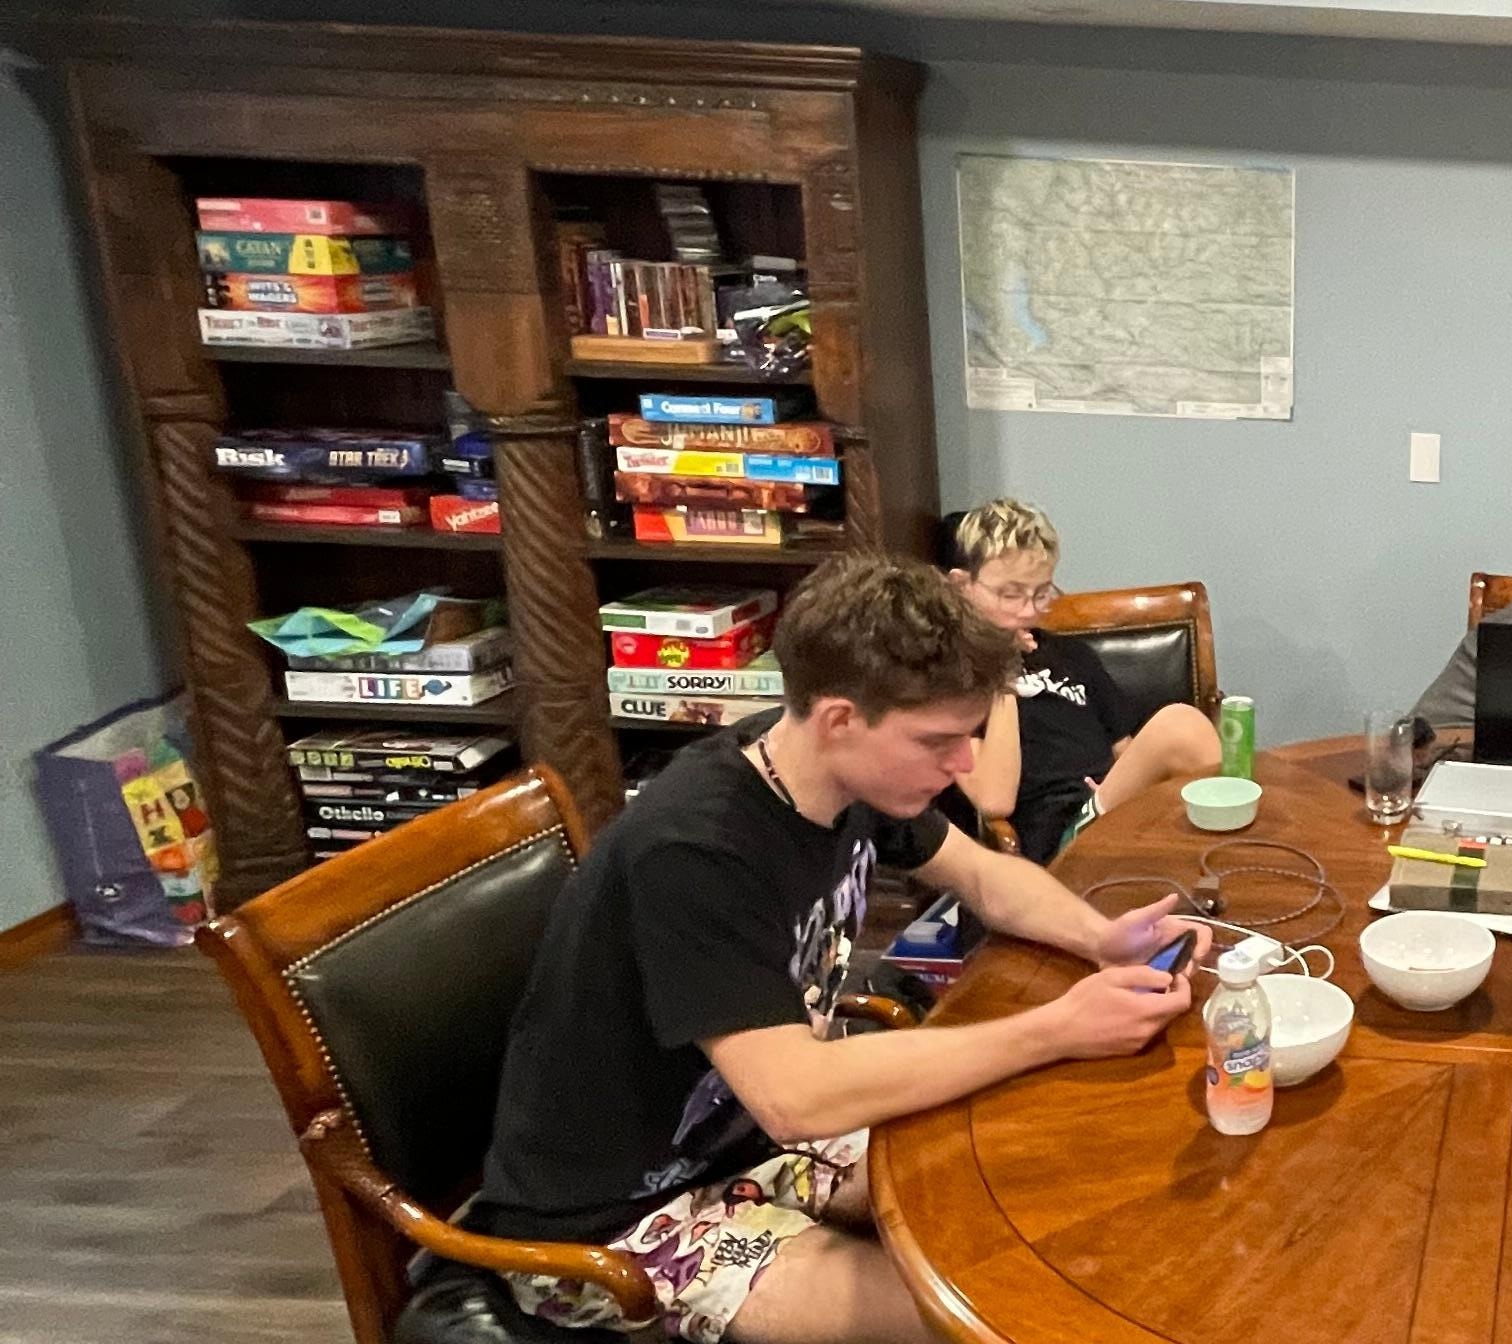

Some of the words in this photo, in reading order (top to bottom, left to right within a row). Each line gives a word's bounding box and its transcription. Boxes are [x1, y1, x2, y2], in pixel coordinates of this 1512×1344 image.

[215, 447, 286, 467] Risk
[328, 450, 364, 467] STAR
[366, 448, 400, 468] TREK
[359, 676, 421, 699] LIFE
[667, 675, 732, 690] SORRY!
[620, 699, 667, 718] CLUE
[318, 805, 385, 822] Othello
